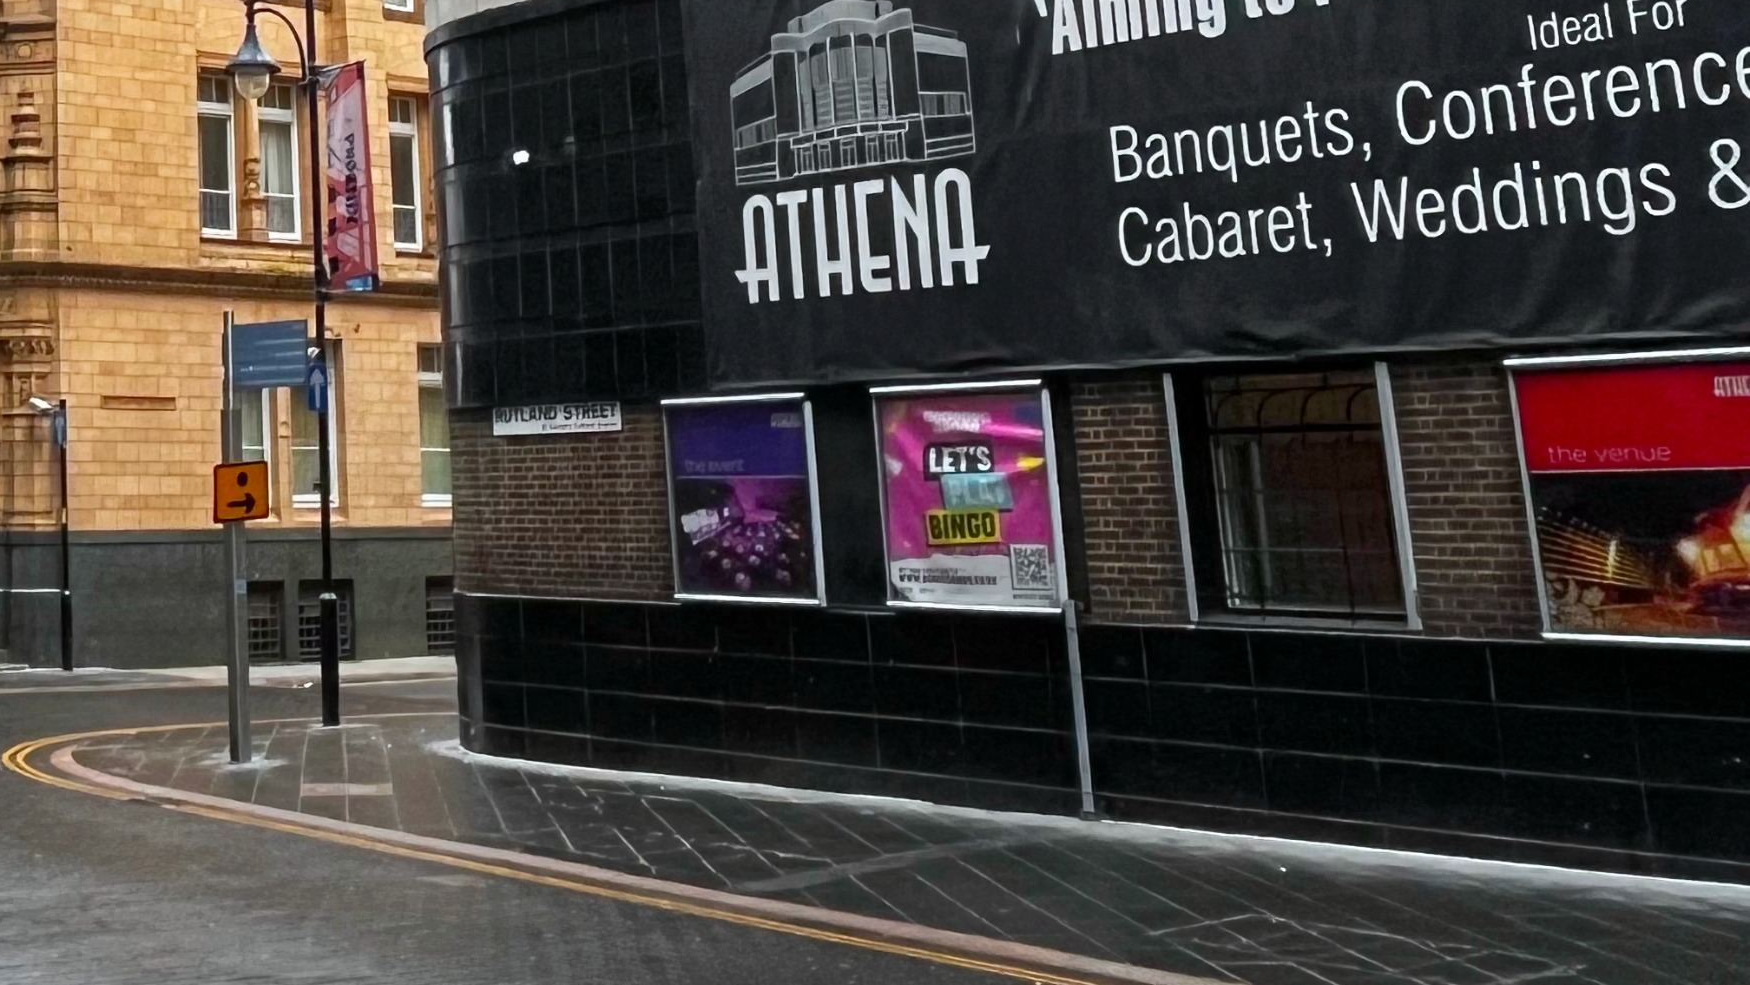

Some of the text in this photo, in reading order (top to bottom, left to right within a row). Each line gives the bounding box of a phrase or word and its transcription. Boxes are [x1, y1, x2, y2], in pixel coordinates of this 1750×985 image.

[1526, 2, 1614, 51] Ideal
[1109, 101, 1373, 184] Banquets,
[1118, 138, 1750, 268] Cabaret, Weddings &
[734, 167, 991, 304] ATHENA
[495, 402, 619, 424] RUTLAND STREET
[928, 446, 992, 473] LET'S
[1548, 446, 1671, 463] the venue
[929, 512, 997, 540] BINGO
